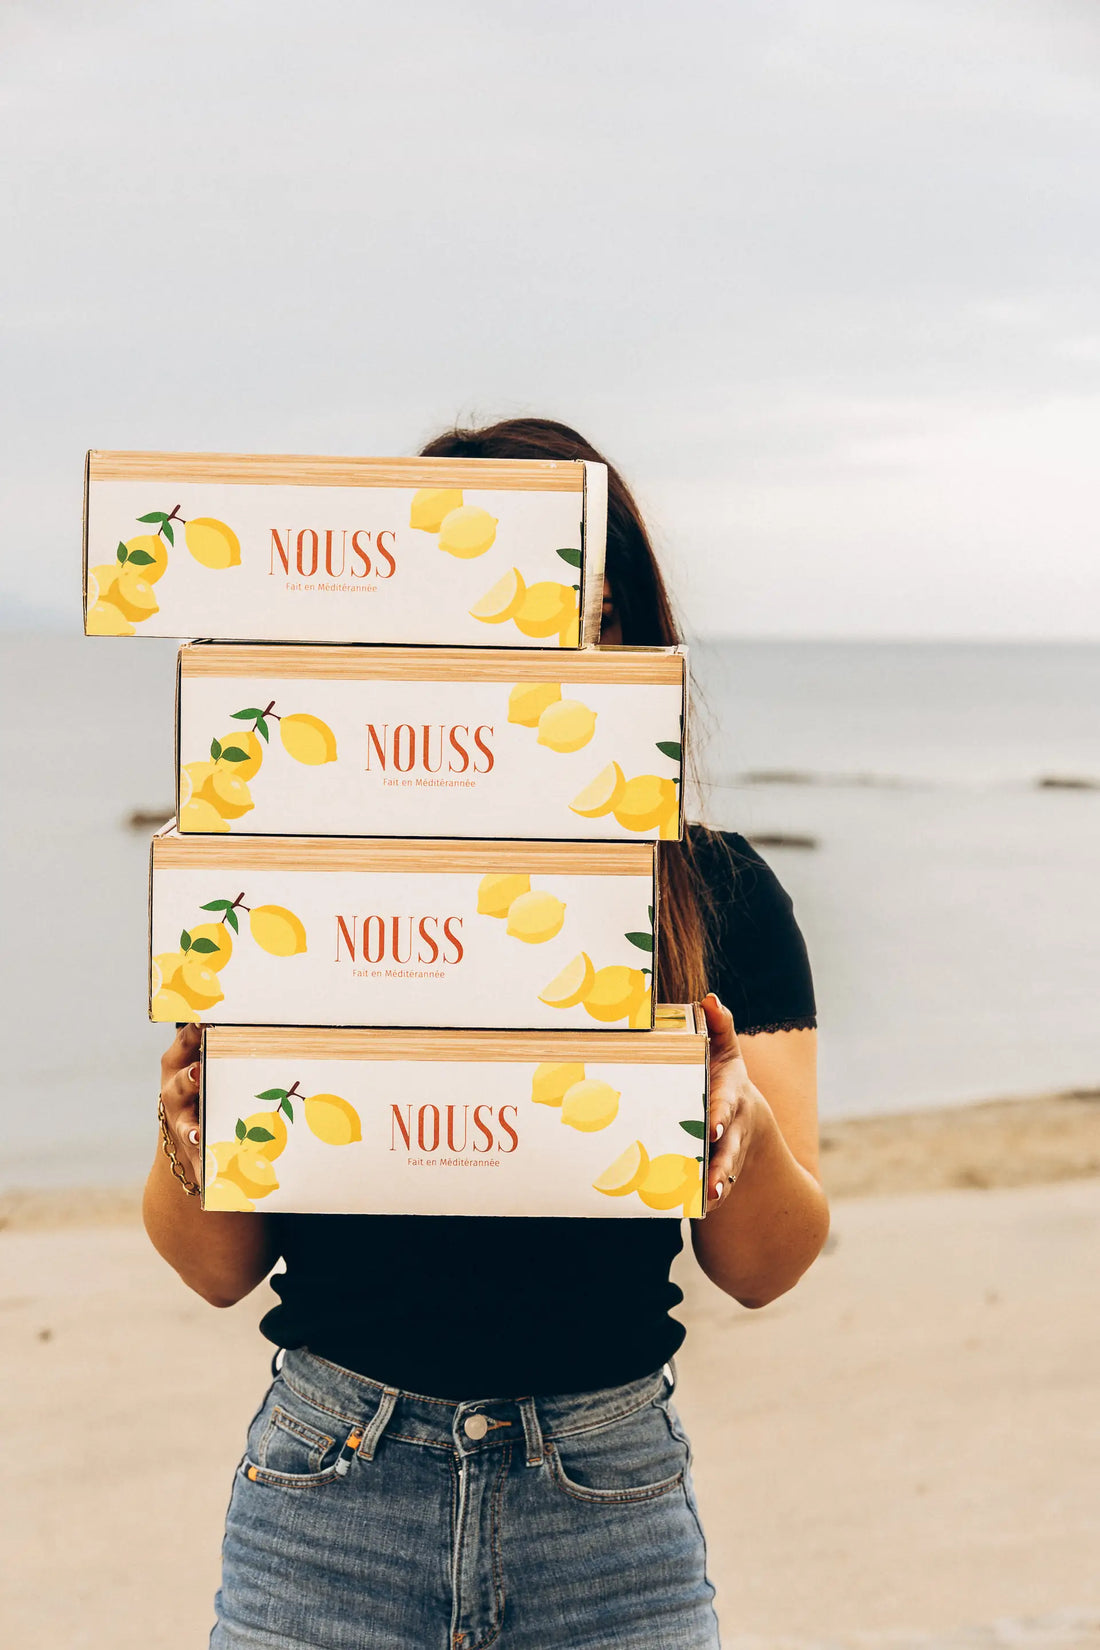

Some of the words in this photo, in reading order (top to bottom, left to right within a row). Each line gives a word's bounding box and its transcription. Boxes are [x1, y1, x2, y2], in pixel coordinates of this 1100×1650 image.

[268, 528, 396, 579] NOUSS
[286, 582, 302, 592] Fait
[304, 584, 315, 592] en
[317, 583, 378, 593] Méditérannée
[364, 723, 494, 774] NOUSS
[383, 777, 399, 787] Fait
[415, 778, 477, 788] Méditérannée
[334, 915, 464, 965] NOUSS
[352, 969, 368, 978] Fait
[384, 969, 445, 979] Méditérannée
[389, 1103, 519, 1153] NOUSS
[407, 1157, 423, 1167] Fait
[426, 1159, 437, 1167] en
[439, 1157, 501, 1168] Méditérannée
